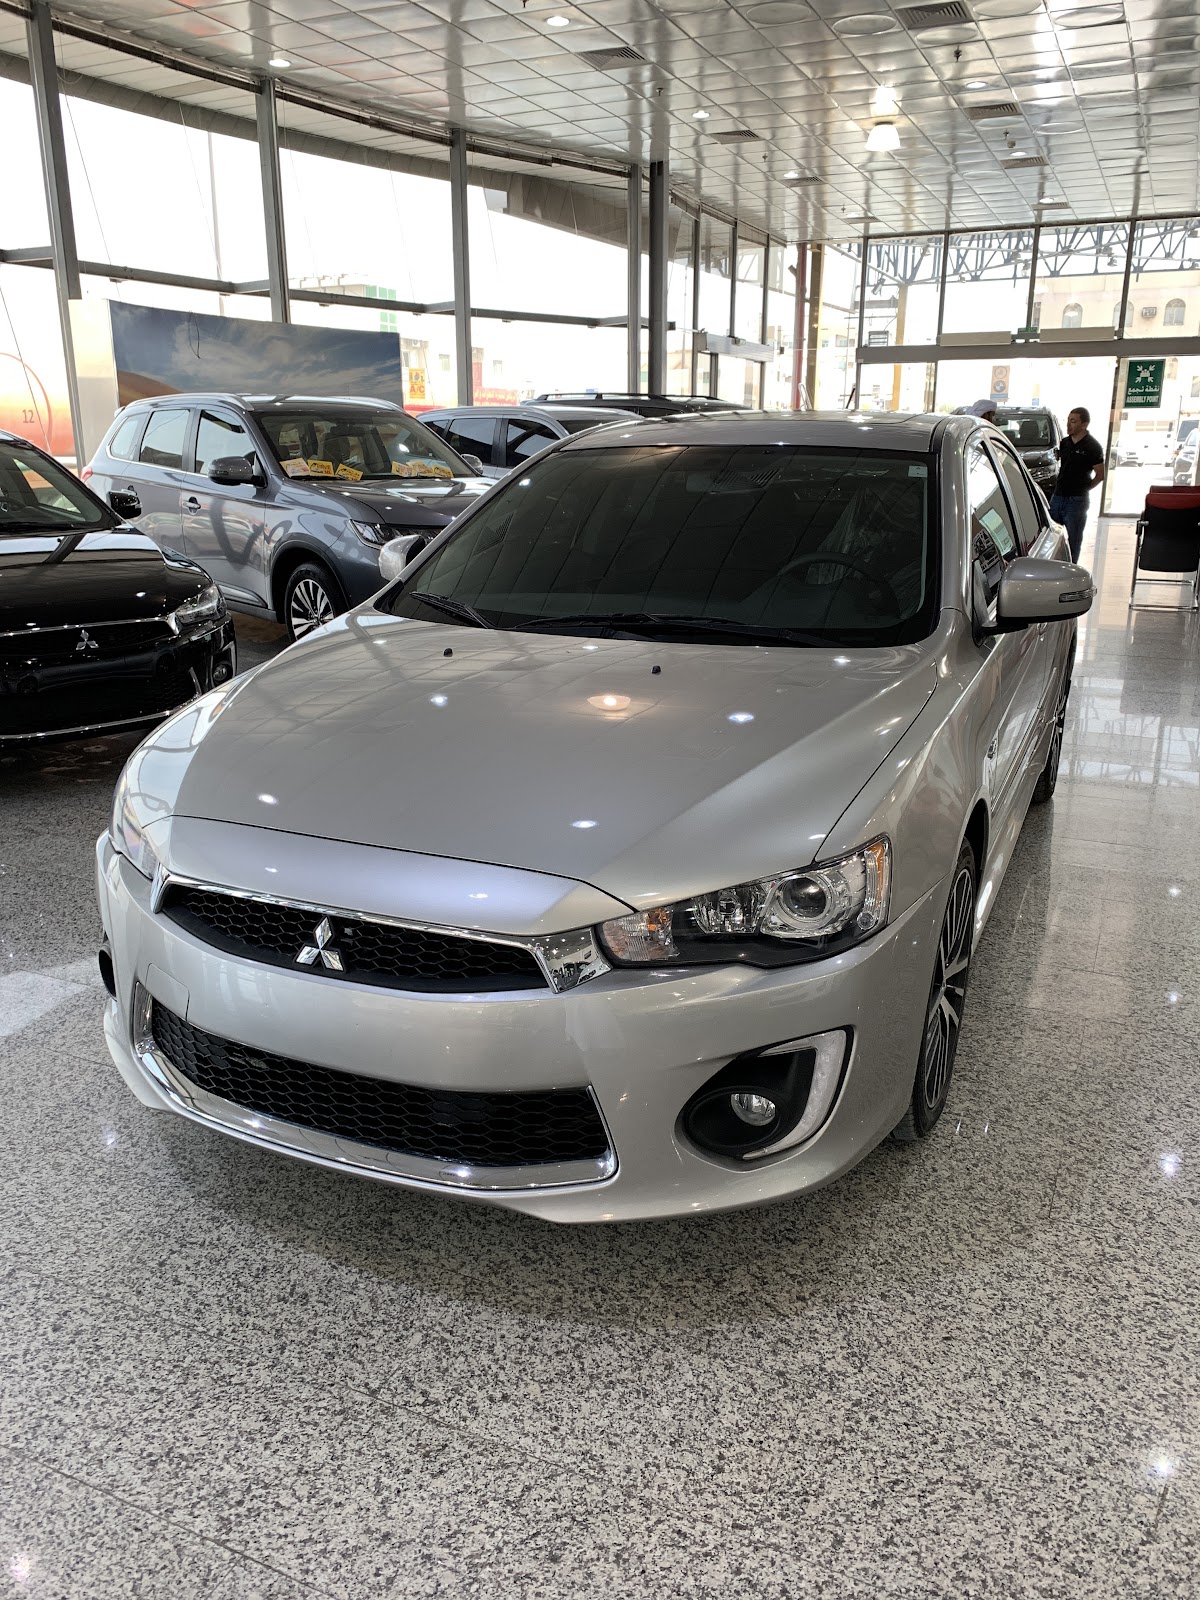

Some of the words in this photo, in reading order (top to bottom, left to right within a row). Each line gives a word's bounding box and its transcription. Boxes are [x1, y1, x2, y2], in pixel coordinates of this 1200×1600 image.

[410, 385, 425, 393] A/C
[1127, 385, 1144, 395] تجمع
[22, 409, 35, 423] 12
